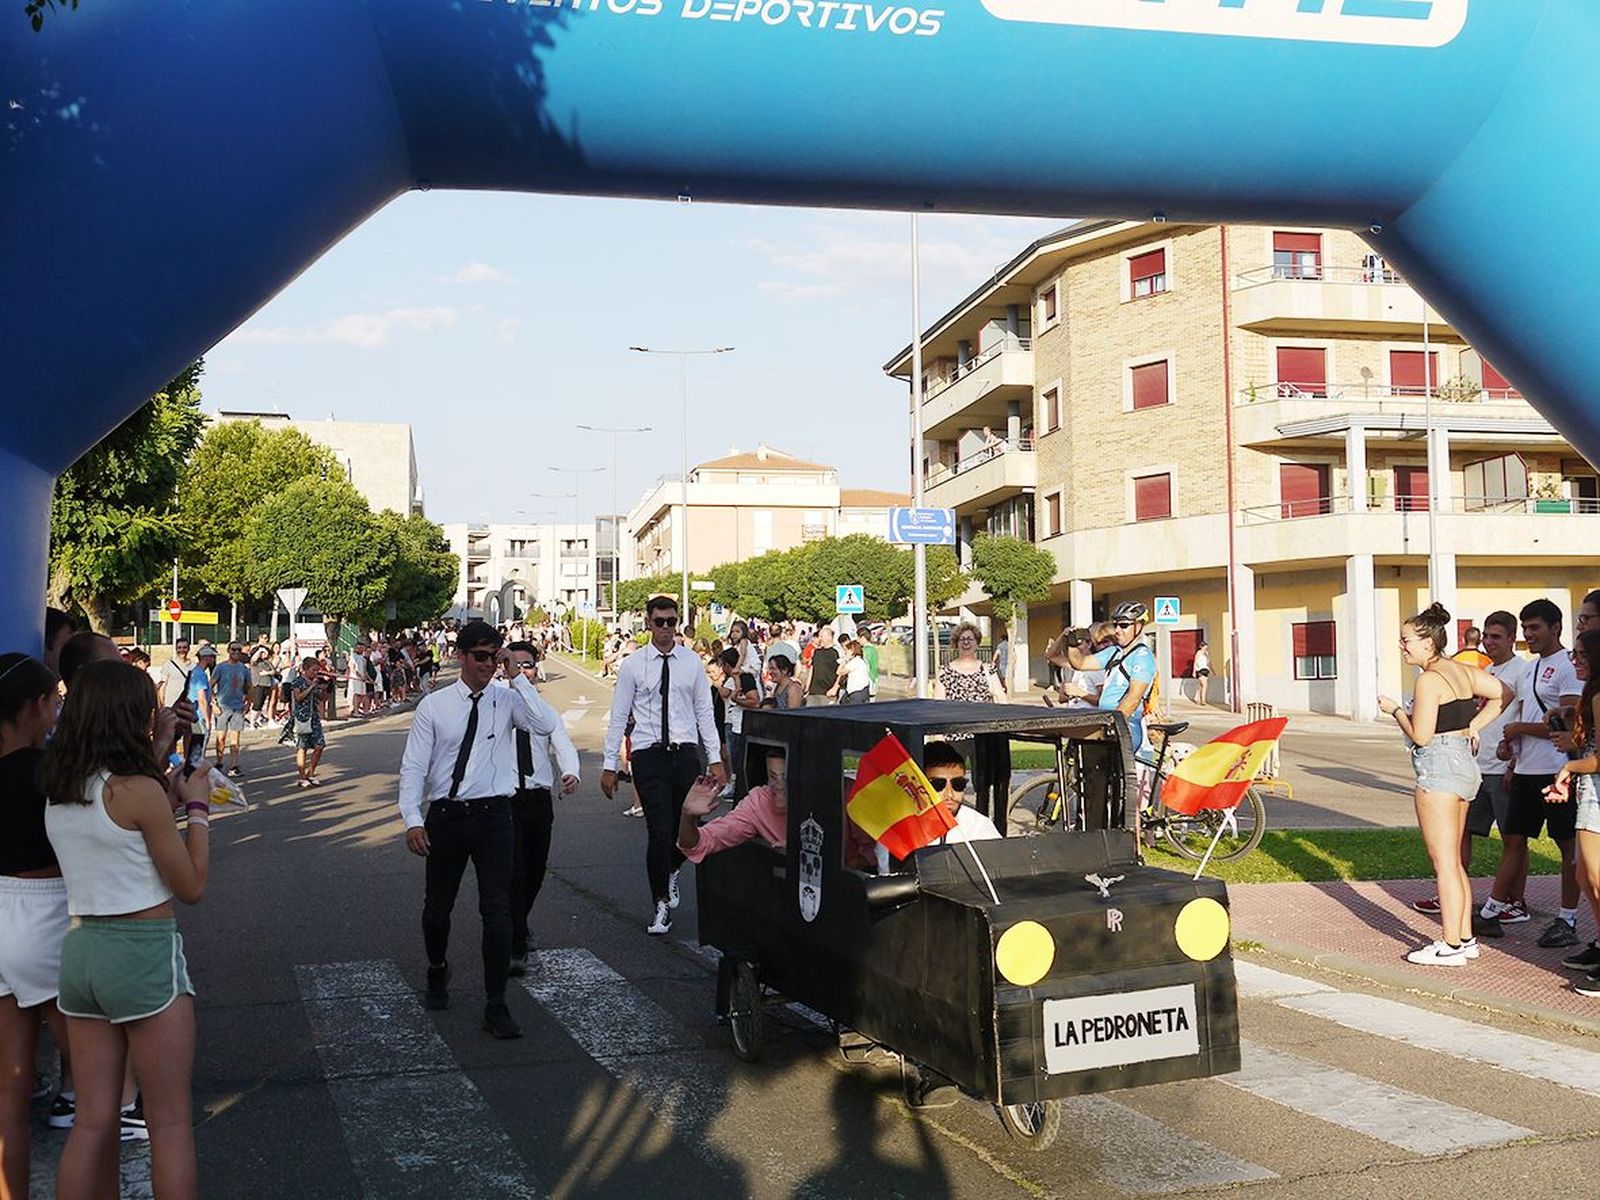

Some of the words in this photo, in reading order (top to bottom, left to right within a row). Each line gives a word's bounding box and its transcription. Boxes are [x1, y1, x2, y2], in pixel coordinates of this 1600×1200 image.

[680, 0, 945, 36] DEPORTIVOS
[1054, 1020, 1080, 1048] LA
[1081, 1006, 1190, 1044] PEDRONETA
